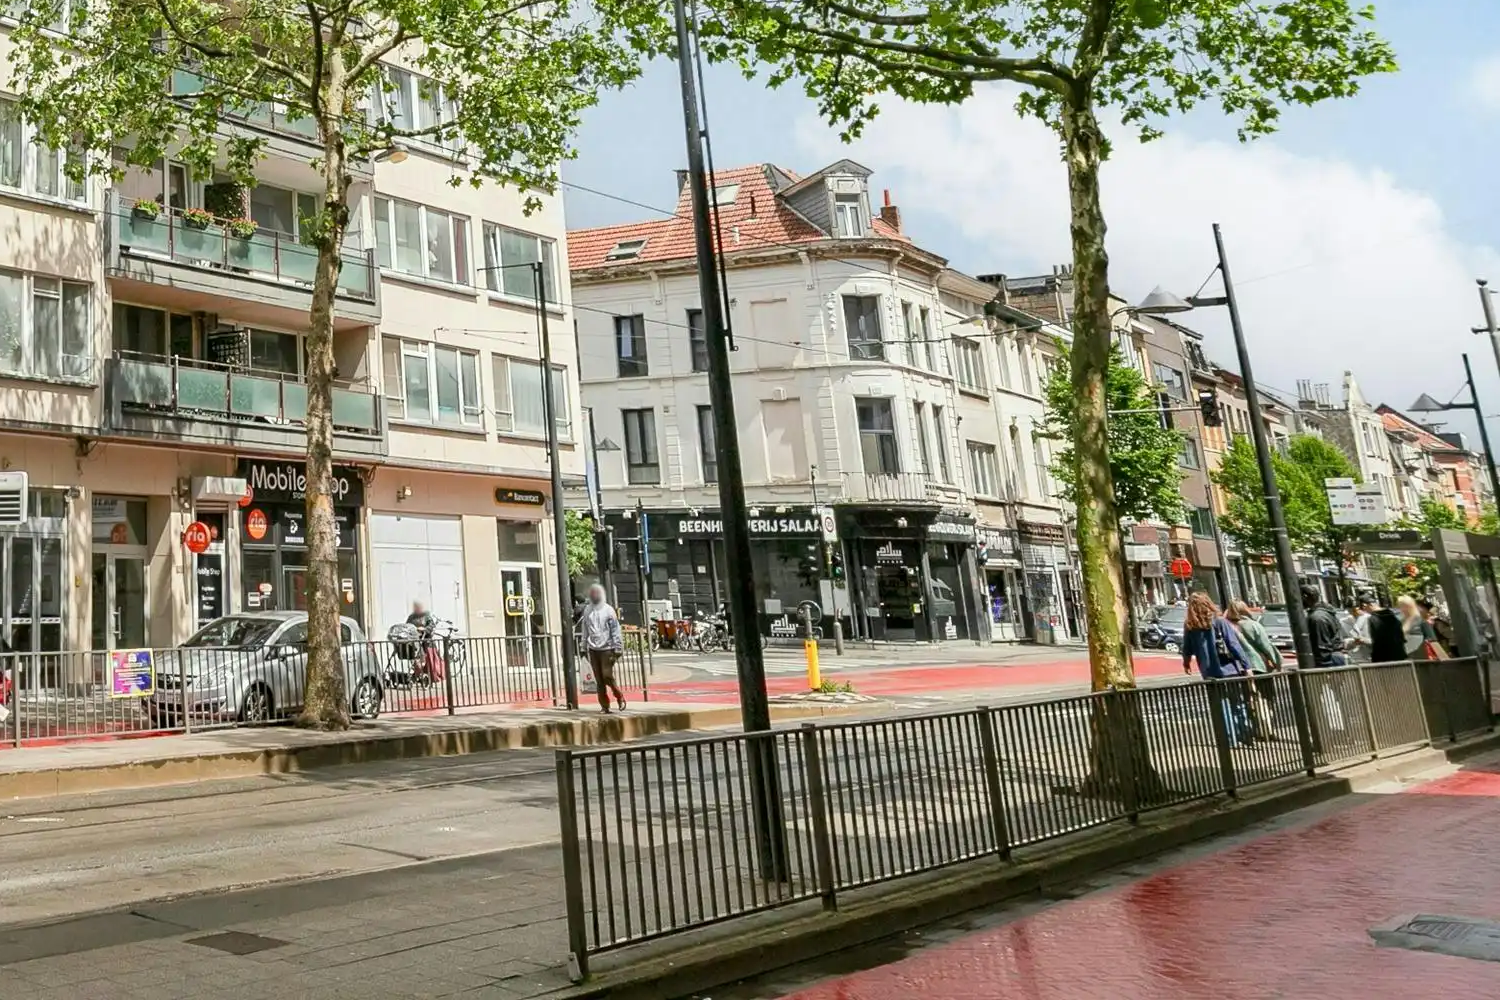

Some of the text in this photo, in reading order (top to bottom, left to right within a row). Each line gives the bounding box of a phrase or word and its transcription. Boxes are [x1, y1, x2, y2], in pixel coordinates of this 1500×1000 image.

[251, 465, 306, 490] Mobile
[250, 513, 267, 528] ria
[679, 519, 778, 533] BEENHERIJ
[187, 527, 206, 542] ria
